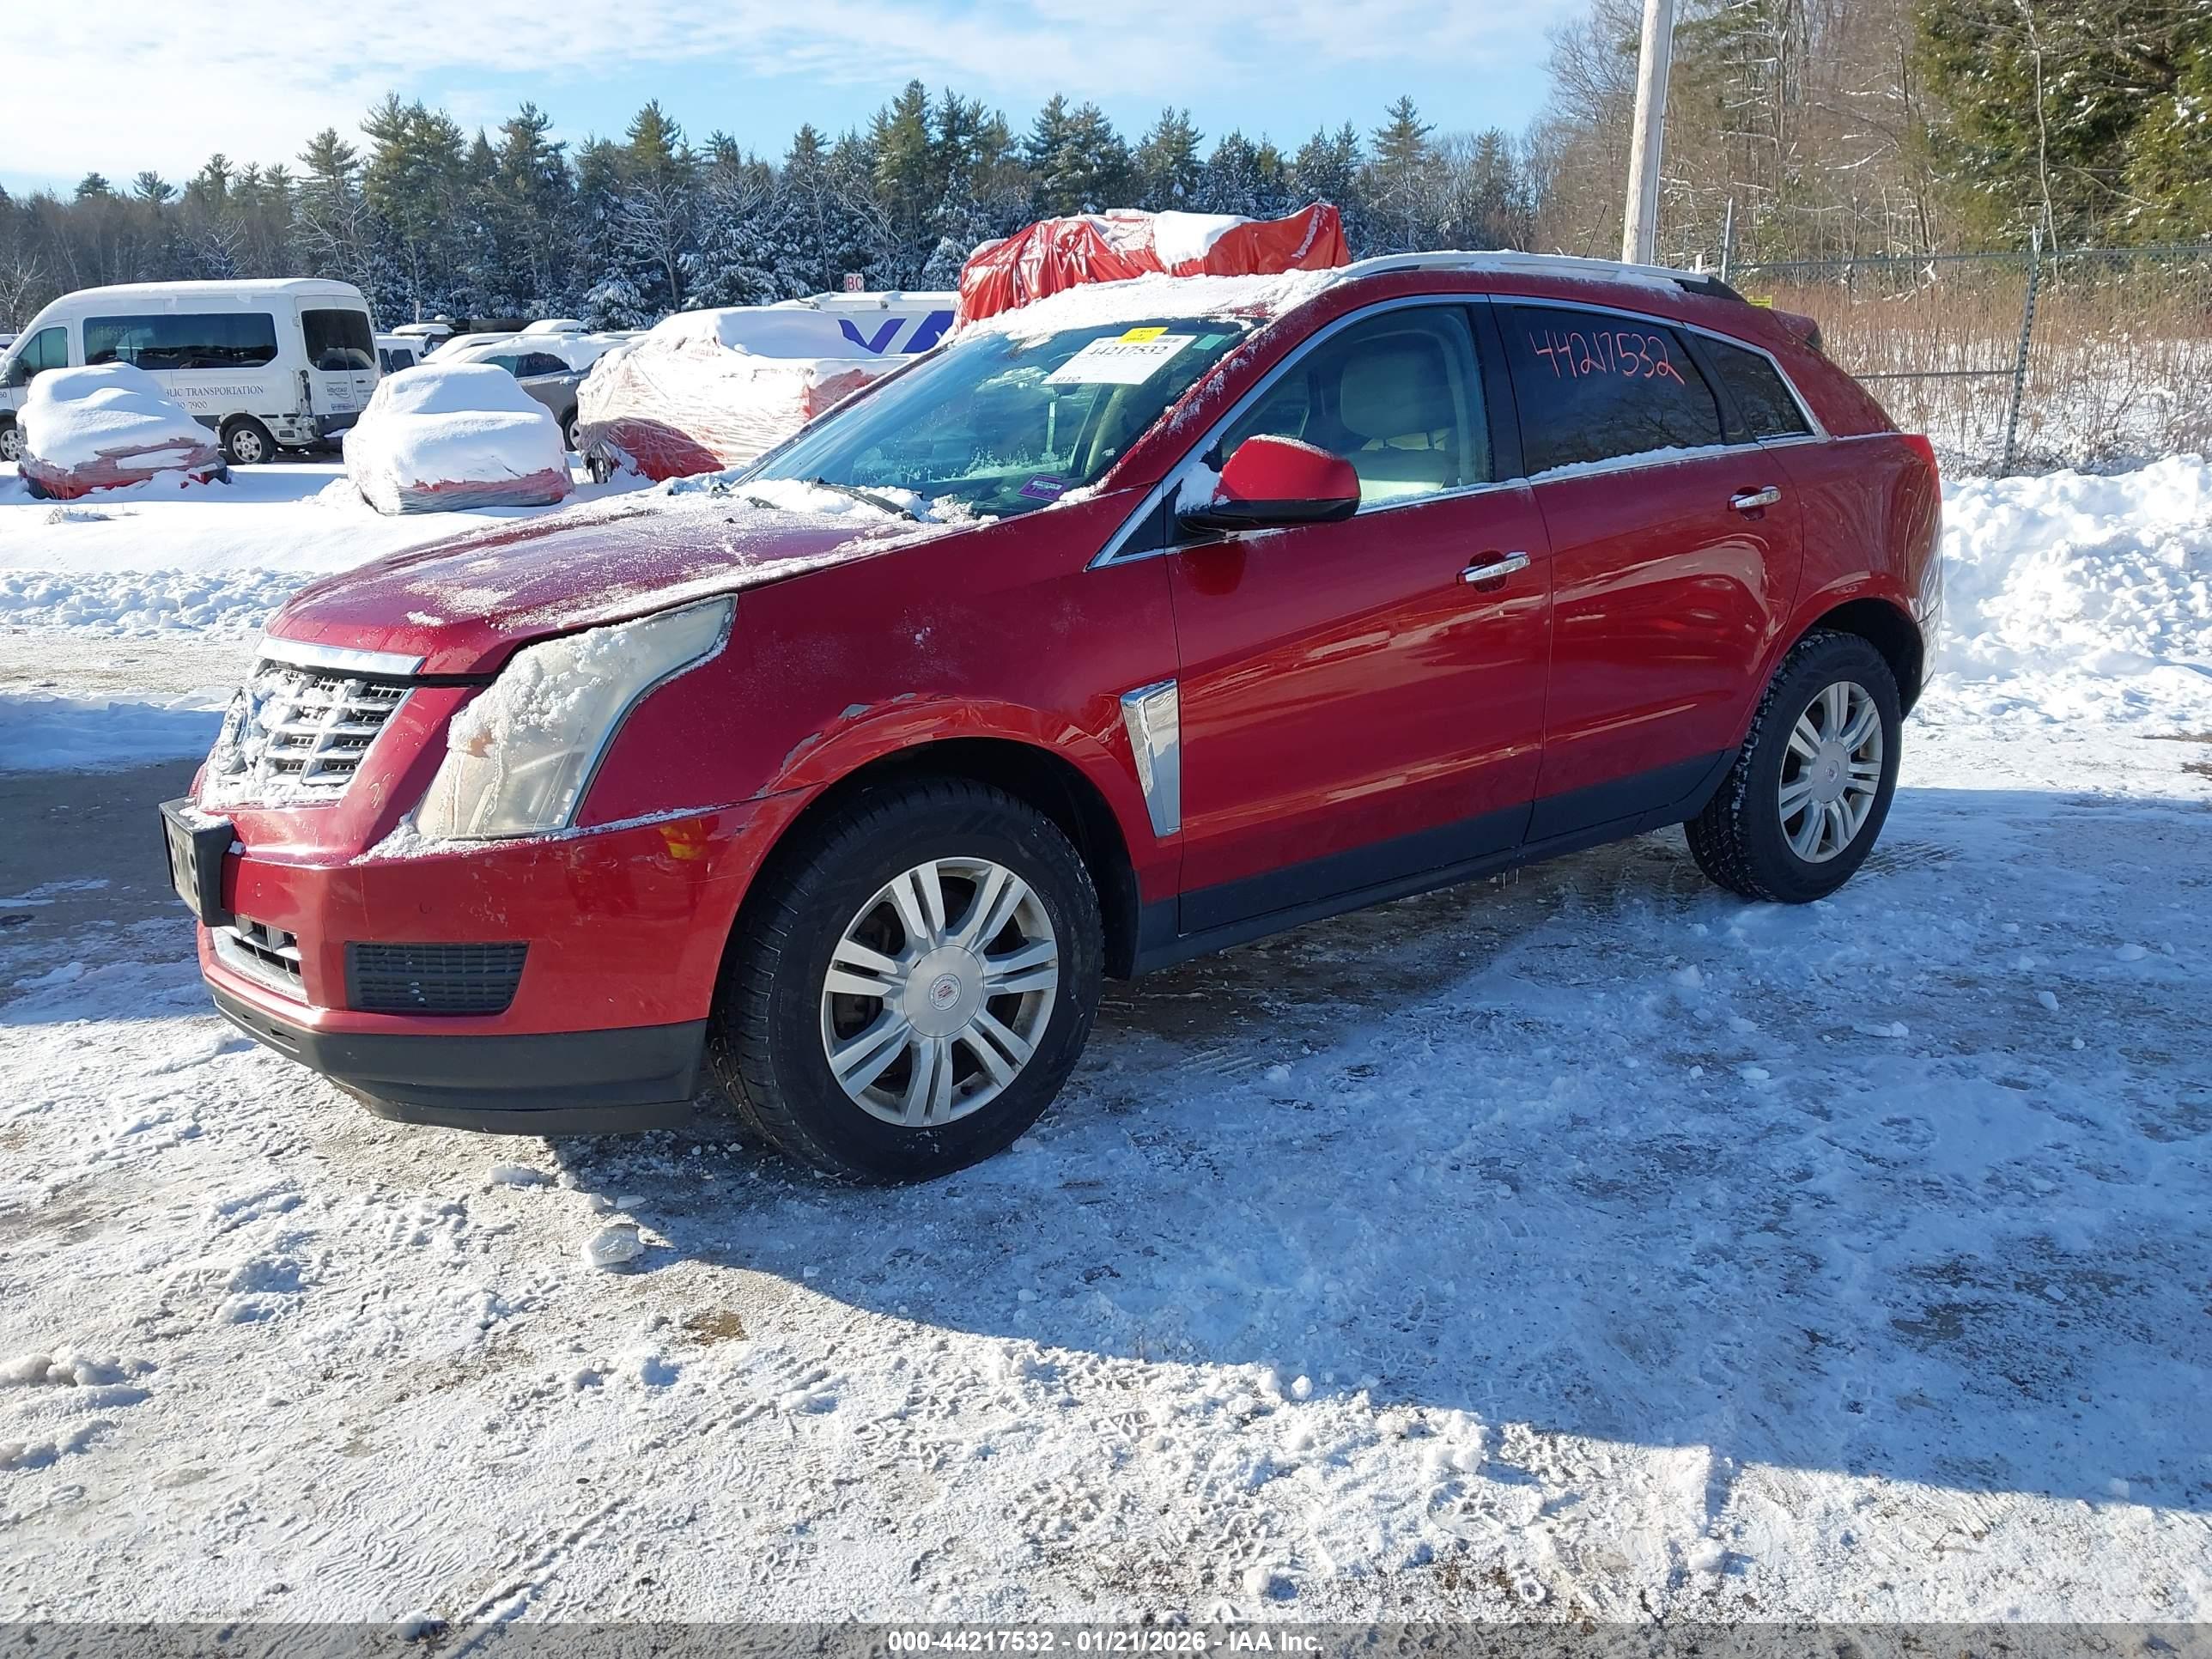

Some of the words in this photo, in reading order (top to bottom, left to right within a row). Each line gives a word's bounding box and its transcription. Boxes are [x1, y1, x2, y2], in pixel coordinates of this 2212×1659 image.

[847, 276, 863, 291] BC
[1087, 346, 1169, 355] 44217532
[1529, 330, 1686, 386] 44217532
[185, 386, 264, 397] TRANSPORTATION
[188, 401, 208, 410] 7900
